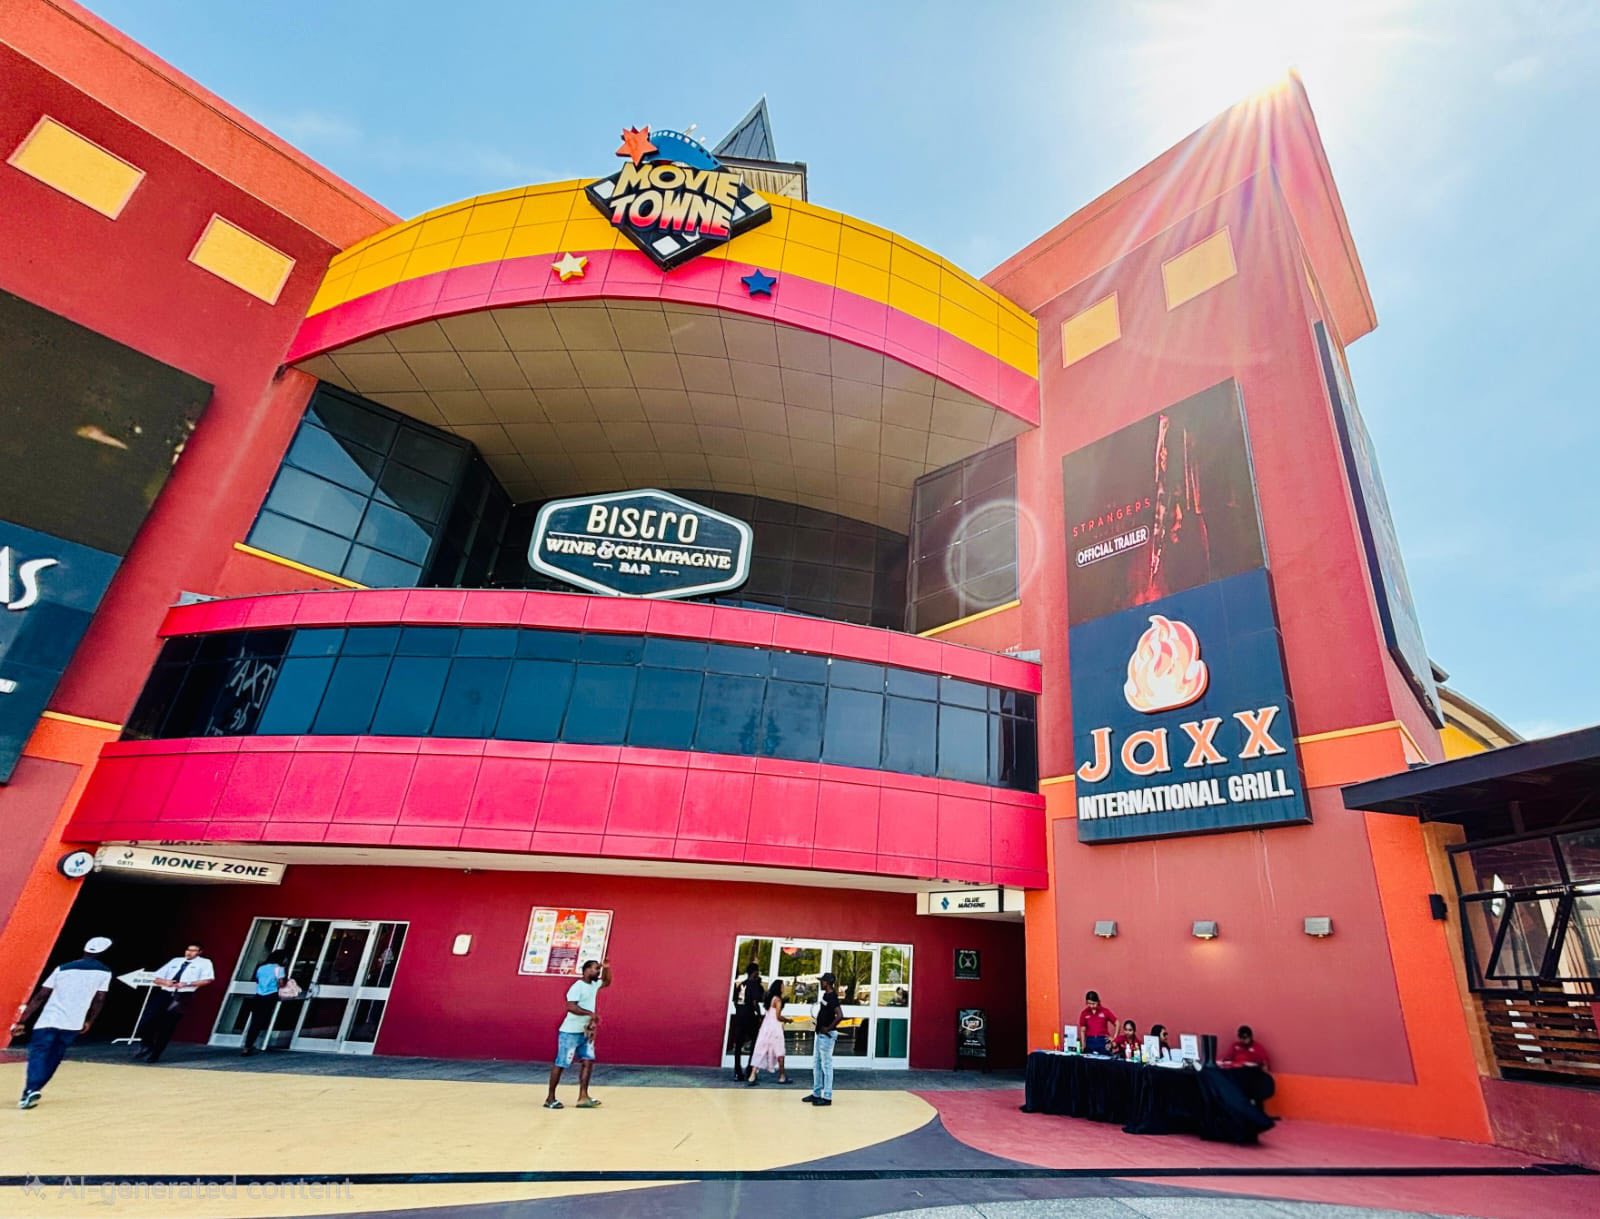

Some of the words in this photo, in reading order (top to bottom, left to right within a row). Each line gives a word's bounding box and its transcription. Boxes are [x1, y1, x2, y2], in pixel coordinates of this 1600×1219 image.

[612, 162, 741, 211] MOVIE
[609, 190, 732, 238] TOWNE
[1072, 497, 1151, 537] STRANGERS
[1077, 540, 1114, 565] OFFICIAL
[1113, 528, 1147, 551] TRAILER
[618, 562, 651, 576] BAR
[1078, 778, 1227, 821] INTERNATIONAL
[1227, 769, 1295, 803] GRILL
[151, 855, 219, 871] MONEY
[221, 863, 270, 878] ZONE
